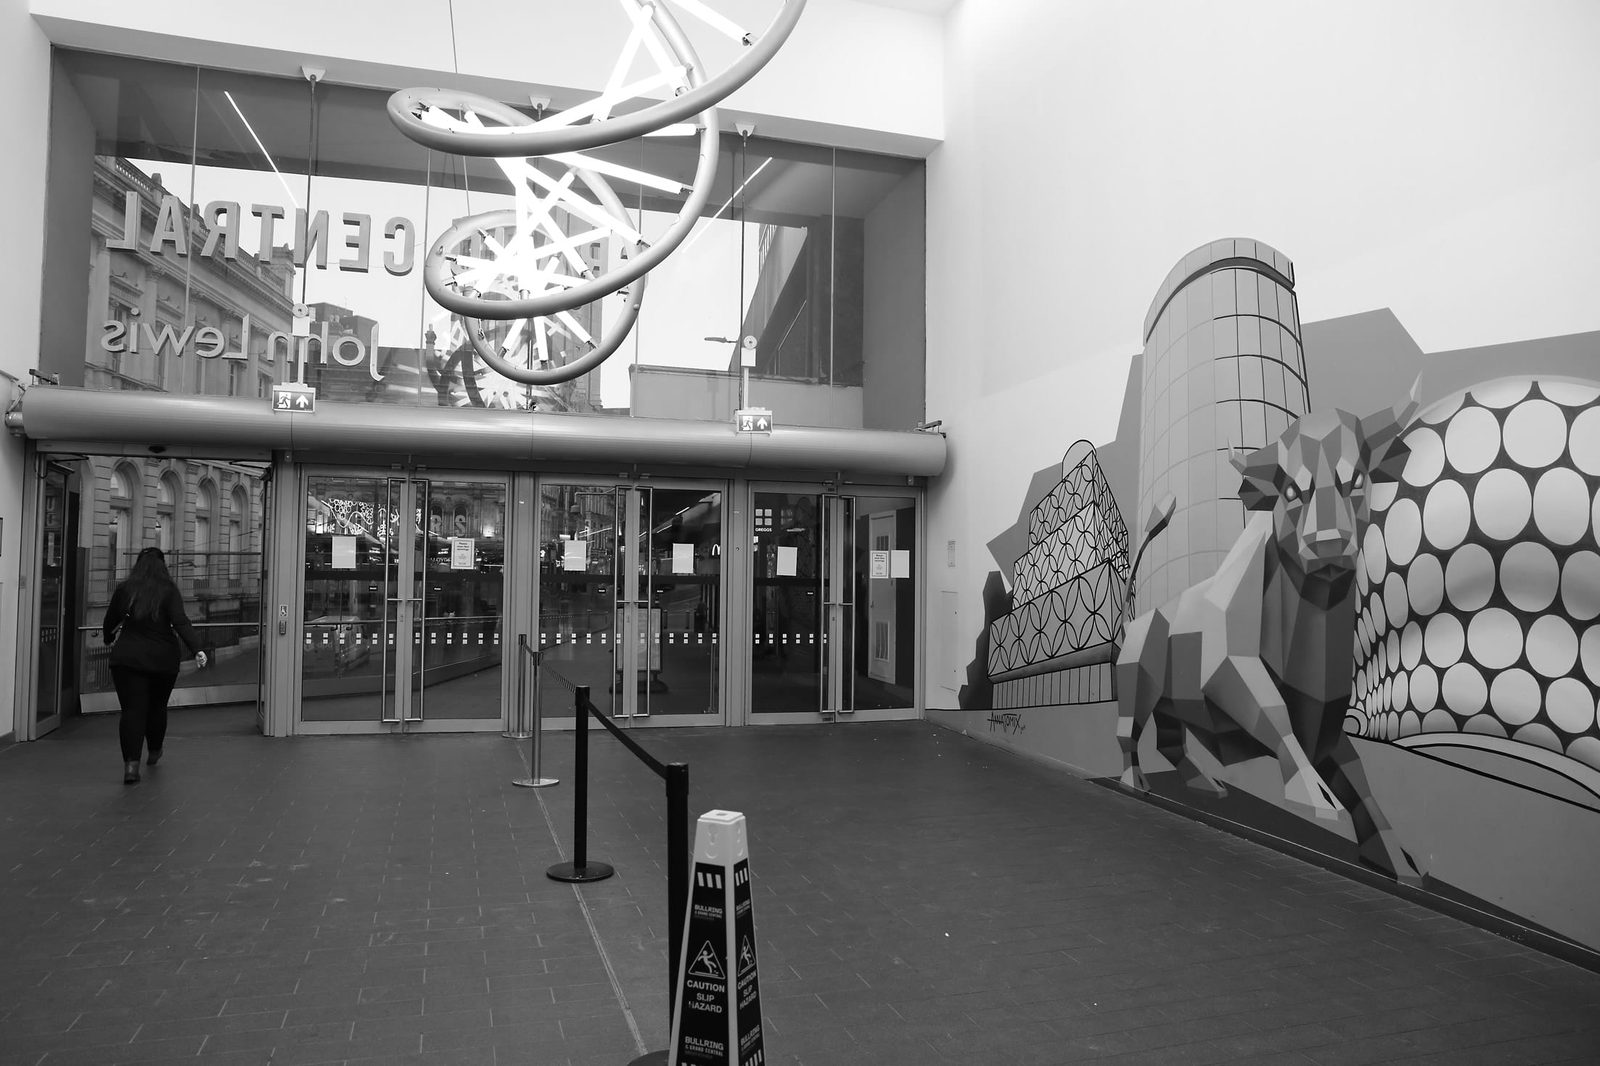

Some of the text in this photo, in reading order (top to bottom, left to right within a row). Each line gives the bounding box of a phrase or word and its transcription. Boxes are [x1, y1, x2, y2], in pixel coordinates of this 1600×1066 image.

[694, 904, 723, 914] BULLRING
[686, 979, 725, 993] CAUTION
[696, 992, 715, 1002] SLIP
[688, 1000, 722, 1013] HAZARD
[684, 1035, 724, 1051] BULLRING
